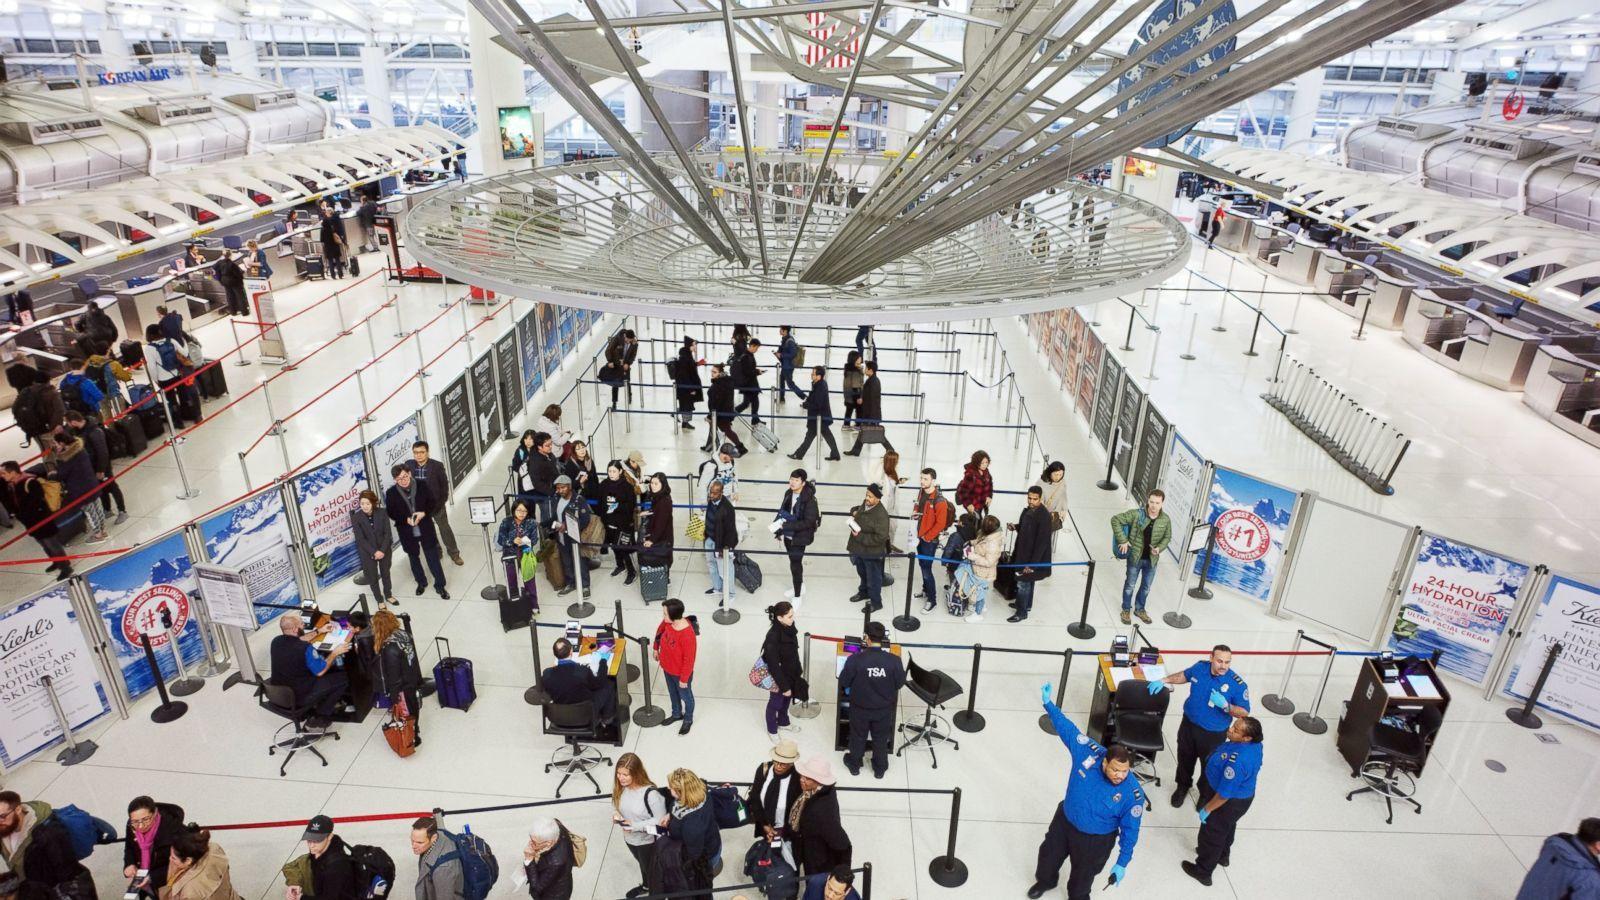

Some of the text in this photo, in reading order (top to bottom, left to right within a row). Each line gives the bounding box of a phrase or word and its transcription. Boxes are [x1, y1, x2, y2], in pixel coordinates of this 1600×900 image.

[97, 68, 171, 86] KOREAN AIR
[308, 499, 361, 531] HYDRATIO
[313, 488, 360, 516] 24-HOUR
[126, 587, 183, 625] OUR BEST SELLING
[1411, 582, 1505, 621] HYDRATION
[1427, 576, 1497, 606] 24-HOUR
[1407, 610, 1430, 622] ULTRA
[1432, 618, 1458, 633] FACIAL
[1460, 630, 1490, 644] CREAM
[1563, 631, 1600, 652] FINE
[4, 648, 53, 678] FINEST
[867, 667, 886, 678] TSA
[2, 664, 73, 704] SKINCRE
